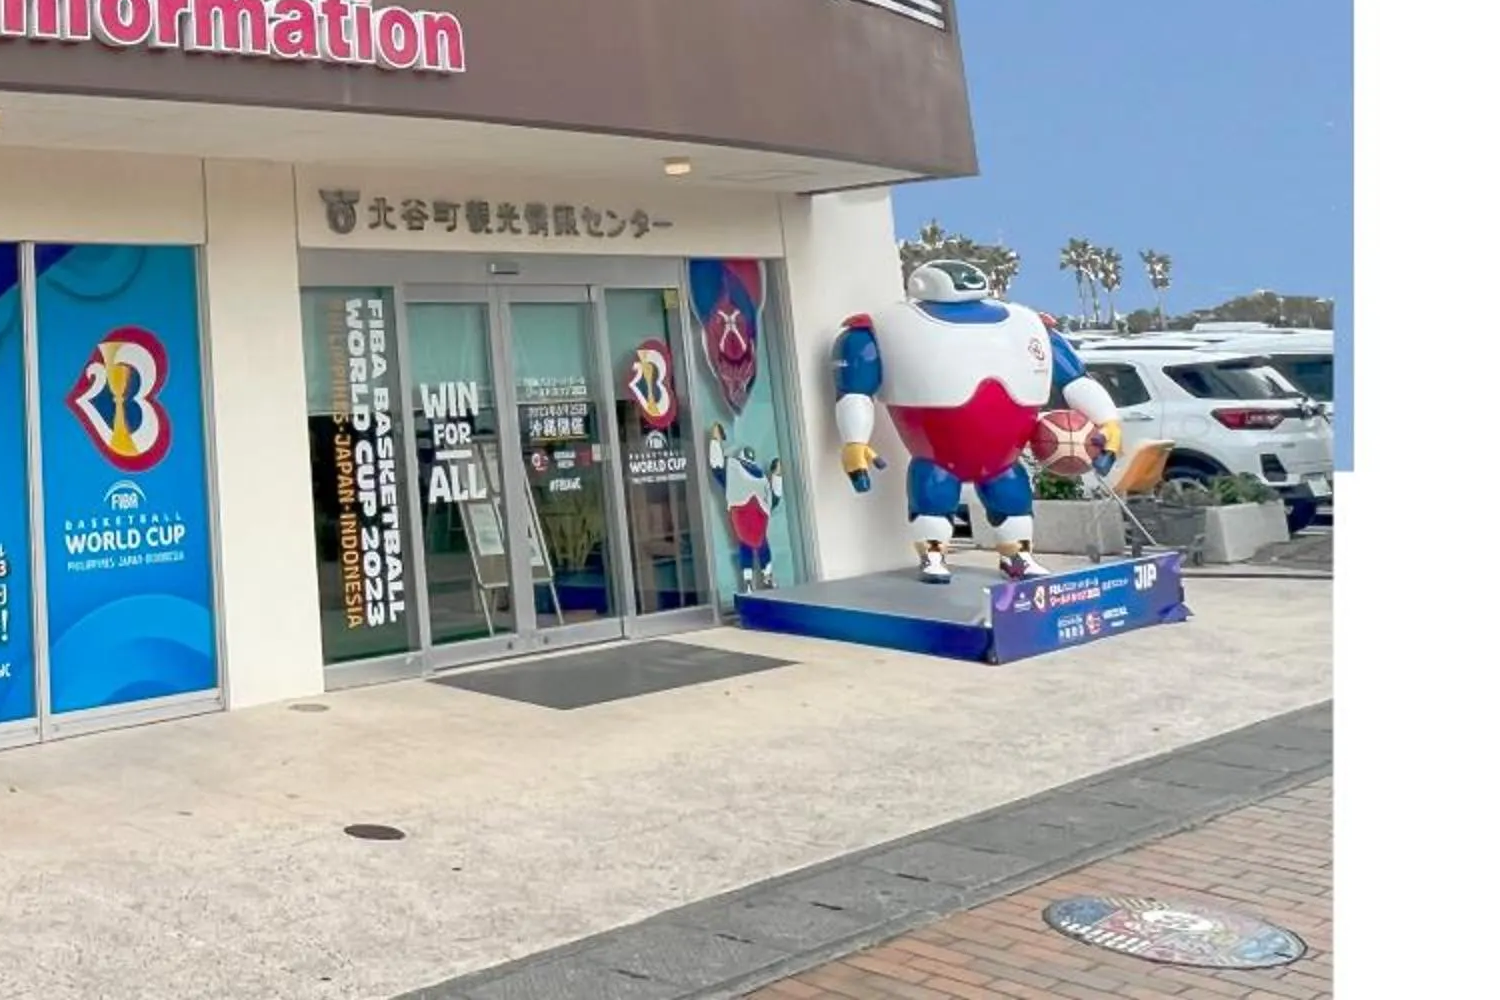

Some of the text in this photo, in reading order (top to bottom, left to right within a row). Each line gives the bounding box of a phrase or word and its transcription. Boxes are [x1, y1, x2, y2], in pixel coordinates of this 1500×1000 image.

[368, 196, 674, 239] 北谷町観光情報センター
[420, 381, 479, 418] WIN
[434, 422, 471, 446] FOR
[345, 299, 385, 627] WORLD CUP 2023
[367, 299, 405, 623] FIBA BASKETBALL
[667, 458, 687, 471] CUP
[428, 463, 487, 504] ALL
[65, 523, 185, 555] WORLD CUP
[1134, 563, 1157, 590] JIP
